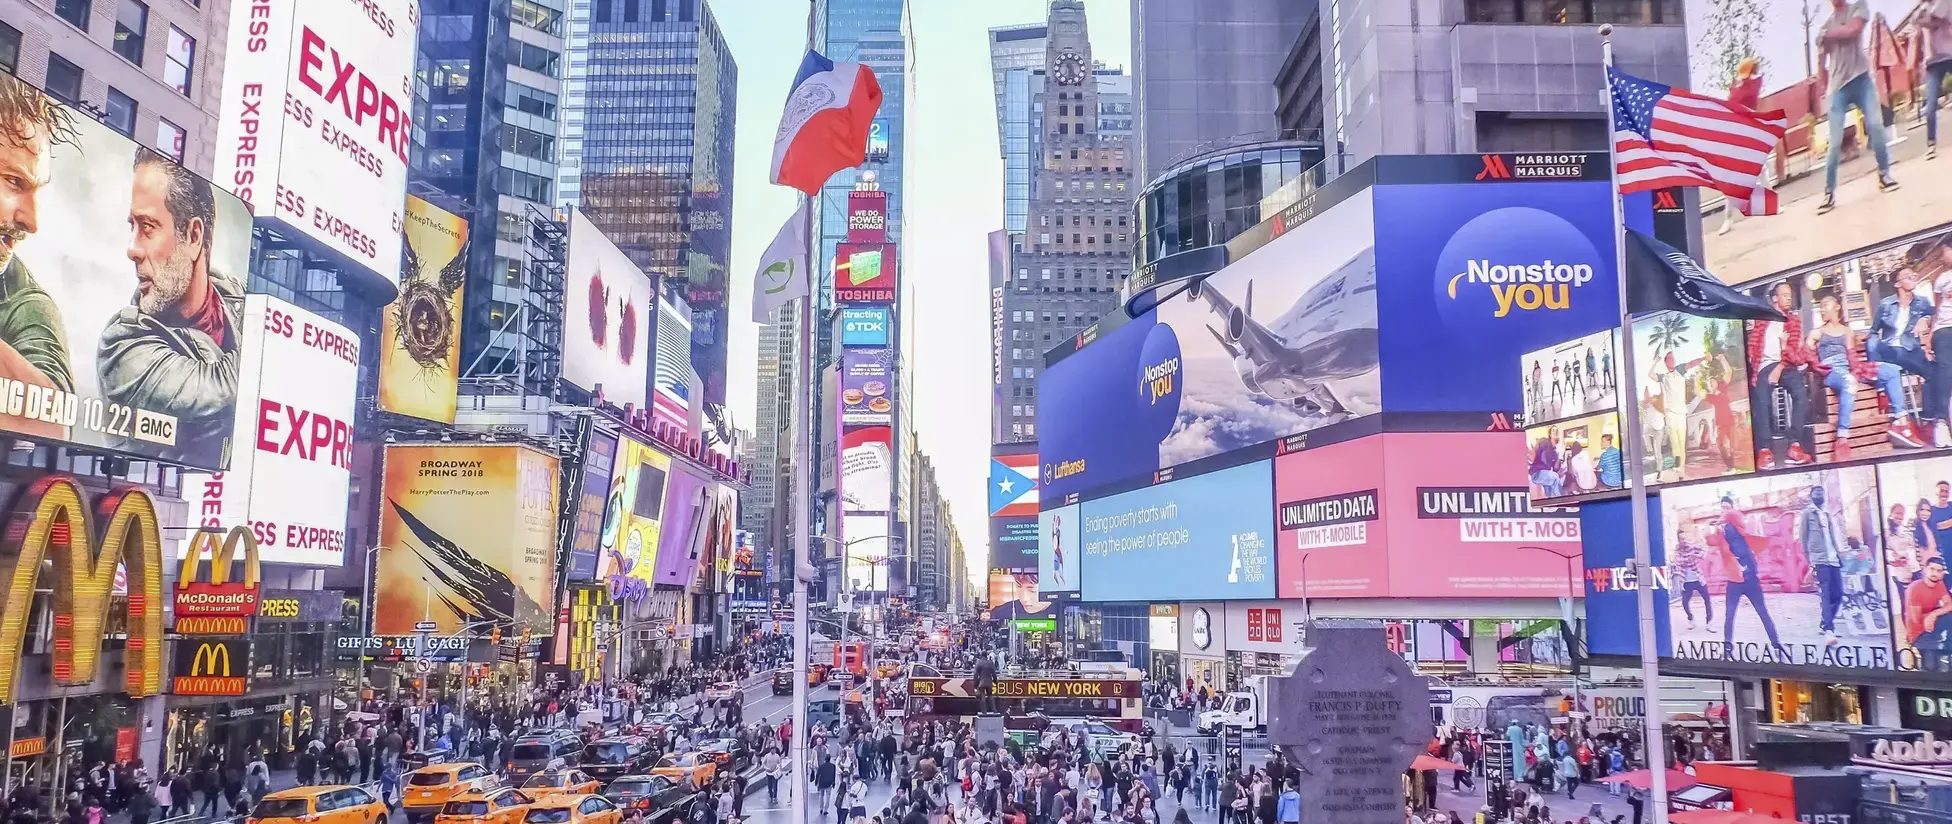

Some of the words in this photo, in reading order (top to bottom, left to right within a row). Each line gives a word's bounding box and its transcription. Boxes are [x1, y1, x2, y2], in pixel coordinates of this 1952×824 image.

[321, 119, 383, 178] EXPRESS
[1515, 154, 1587, 164] MARRIOTT
[1516, 166, 1579, 176] MARQUIS
[1285, 193, 1317, 217] MARRIOTT
[405, 209, 460, 240] #KeepTheSecrets
[849, 216, 884, 224] POWER
[1285, 208, 1313, 229] MARQUIS
[314, 207, 376, 259] EXPRESS
[1467, 259, 1593, 287] Nonstop
[836, 290, 893, 300] TOSHIBA
[1490, 283, 1570, 317] you
[855, 322, 883, 331] TDK
[302, 322, 358, 367] EXPRESS
[1145, 357, 1179, 384] Nonstop
[1150, 374, 1172, 405] you
[25, 385, 78, 427] DEAD
[82, 397, 132, 438] 10.22
[420, 460, 483, 468] BROADWAY
[1054, 458, 1085, 480] Lufthansa
[564, 468, 578, 515] MAC
[1085, 516, 1108, 533] Ending
[1109, 509, 1137, 532] poverty
[1138, 504, 1158, 524] starts
[1160, 500, 1177, 519] with
[1282, 499, 1341, 526] UNLIMITED
[1342, 495, 1376, 518] DATA
[286, 524, 344, 553] EXPRESS
[1299, 529, 1321, 545] WITH
[1321, 524, 1364, 544] T-MOBILE
[1464, 521, 1513, 539] WITH
[1518, 521, 1578, 538] T-MOB
[555, 519, 569, 566] MAC
[1085, 538, 1107, 557] seeing
[1108, 536, 1120, 552] the
[1121, 535, 1146, 555] power
[1147, 529, 1157, 548] of
[1157, 525, 1192, 551] people.
[176, 593, 254, 604] McDonald's
[259, 599, 300, 617] PRESS
[1267, 613, 1279, 625] UNI
[337, 637, 383, 649] GIFTS
[1267, 626, 1280, 639] QLO
[1675, 640, 1795, 665] AMERICAN
[1804, 643, 1891, 669] EAGLE
[1028, 682, 1059, 695] NEW
[1065, 682, 1101, 695] YORK
[230, 707, 254, 718] EXPRESS
[1309, 702, 1352, 712] FRANCIS
[1366, 701, 1402, 711] DUFFY
[1594, 696, 1646, 717] PROUD
